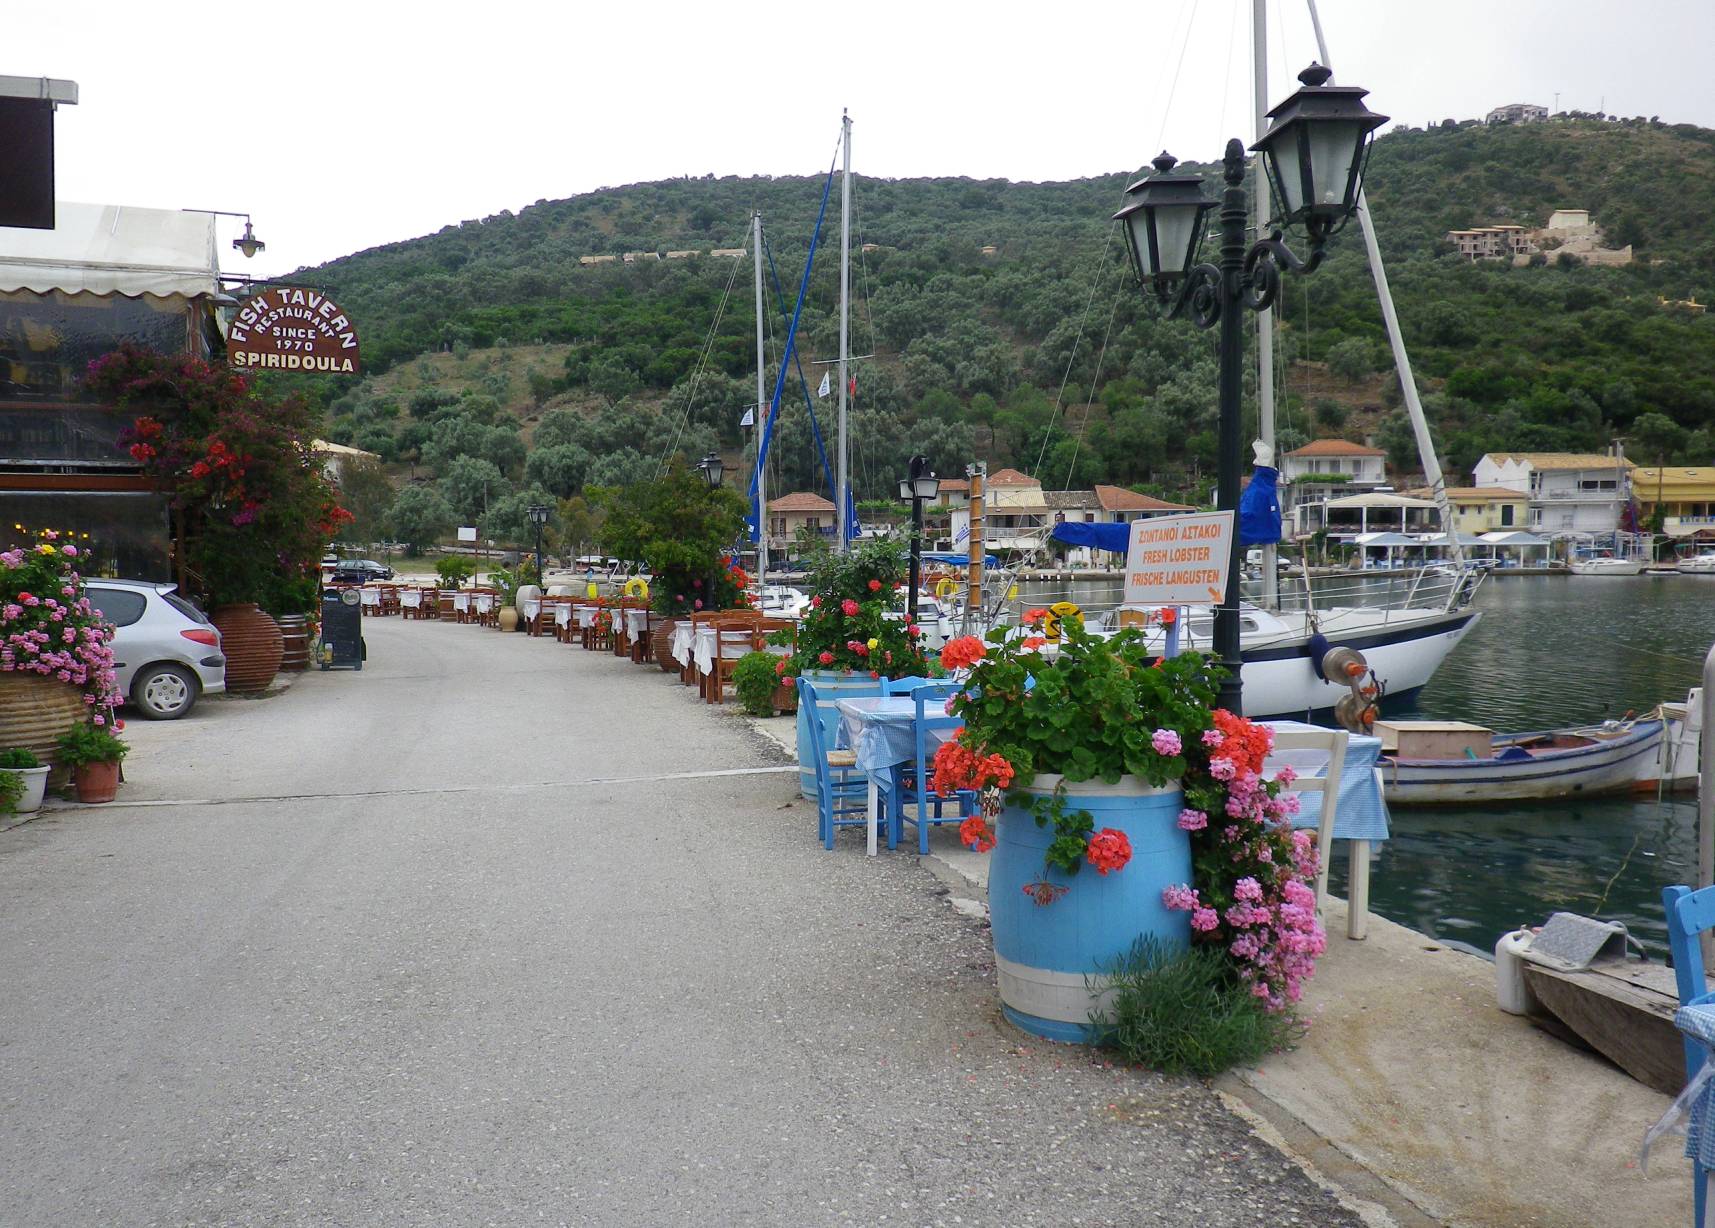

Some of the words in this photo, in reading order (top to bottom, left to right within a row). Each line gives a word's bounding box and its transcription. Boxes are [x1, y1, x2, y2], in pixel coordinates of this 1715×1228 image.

[231, 296, 269, 342] FISH
[277, 288, 357, 349] TAVERN
[254, 307, 335, 338] RESTAURANT
[272, 326, 316, 339] SINCE
[276, 339, 313, 351] 1970
[234, 351, 354, 372] SPIRIDOULA
[1143, 549, 1167, 564] FRESH
[1170, 546, 1210, 561] LOBSTER
[1131, 571, 1164, 586] FRISCHE
[1166, 569, 1220, 585] LANGUSTEN
